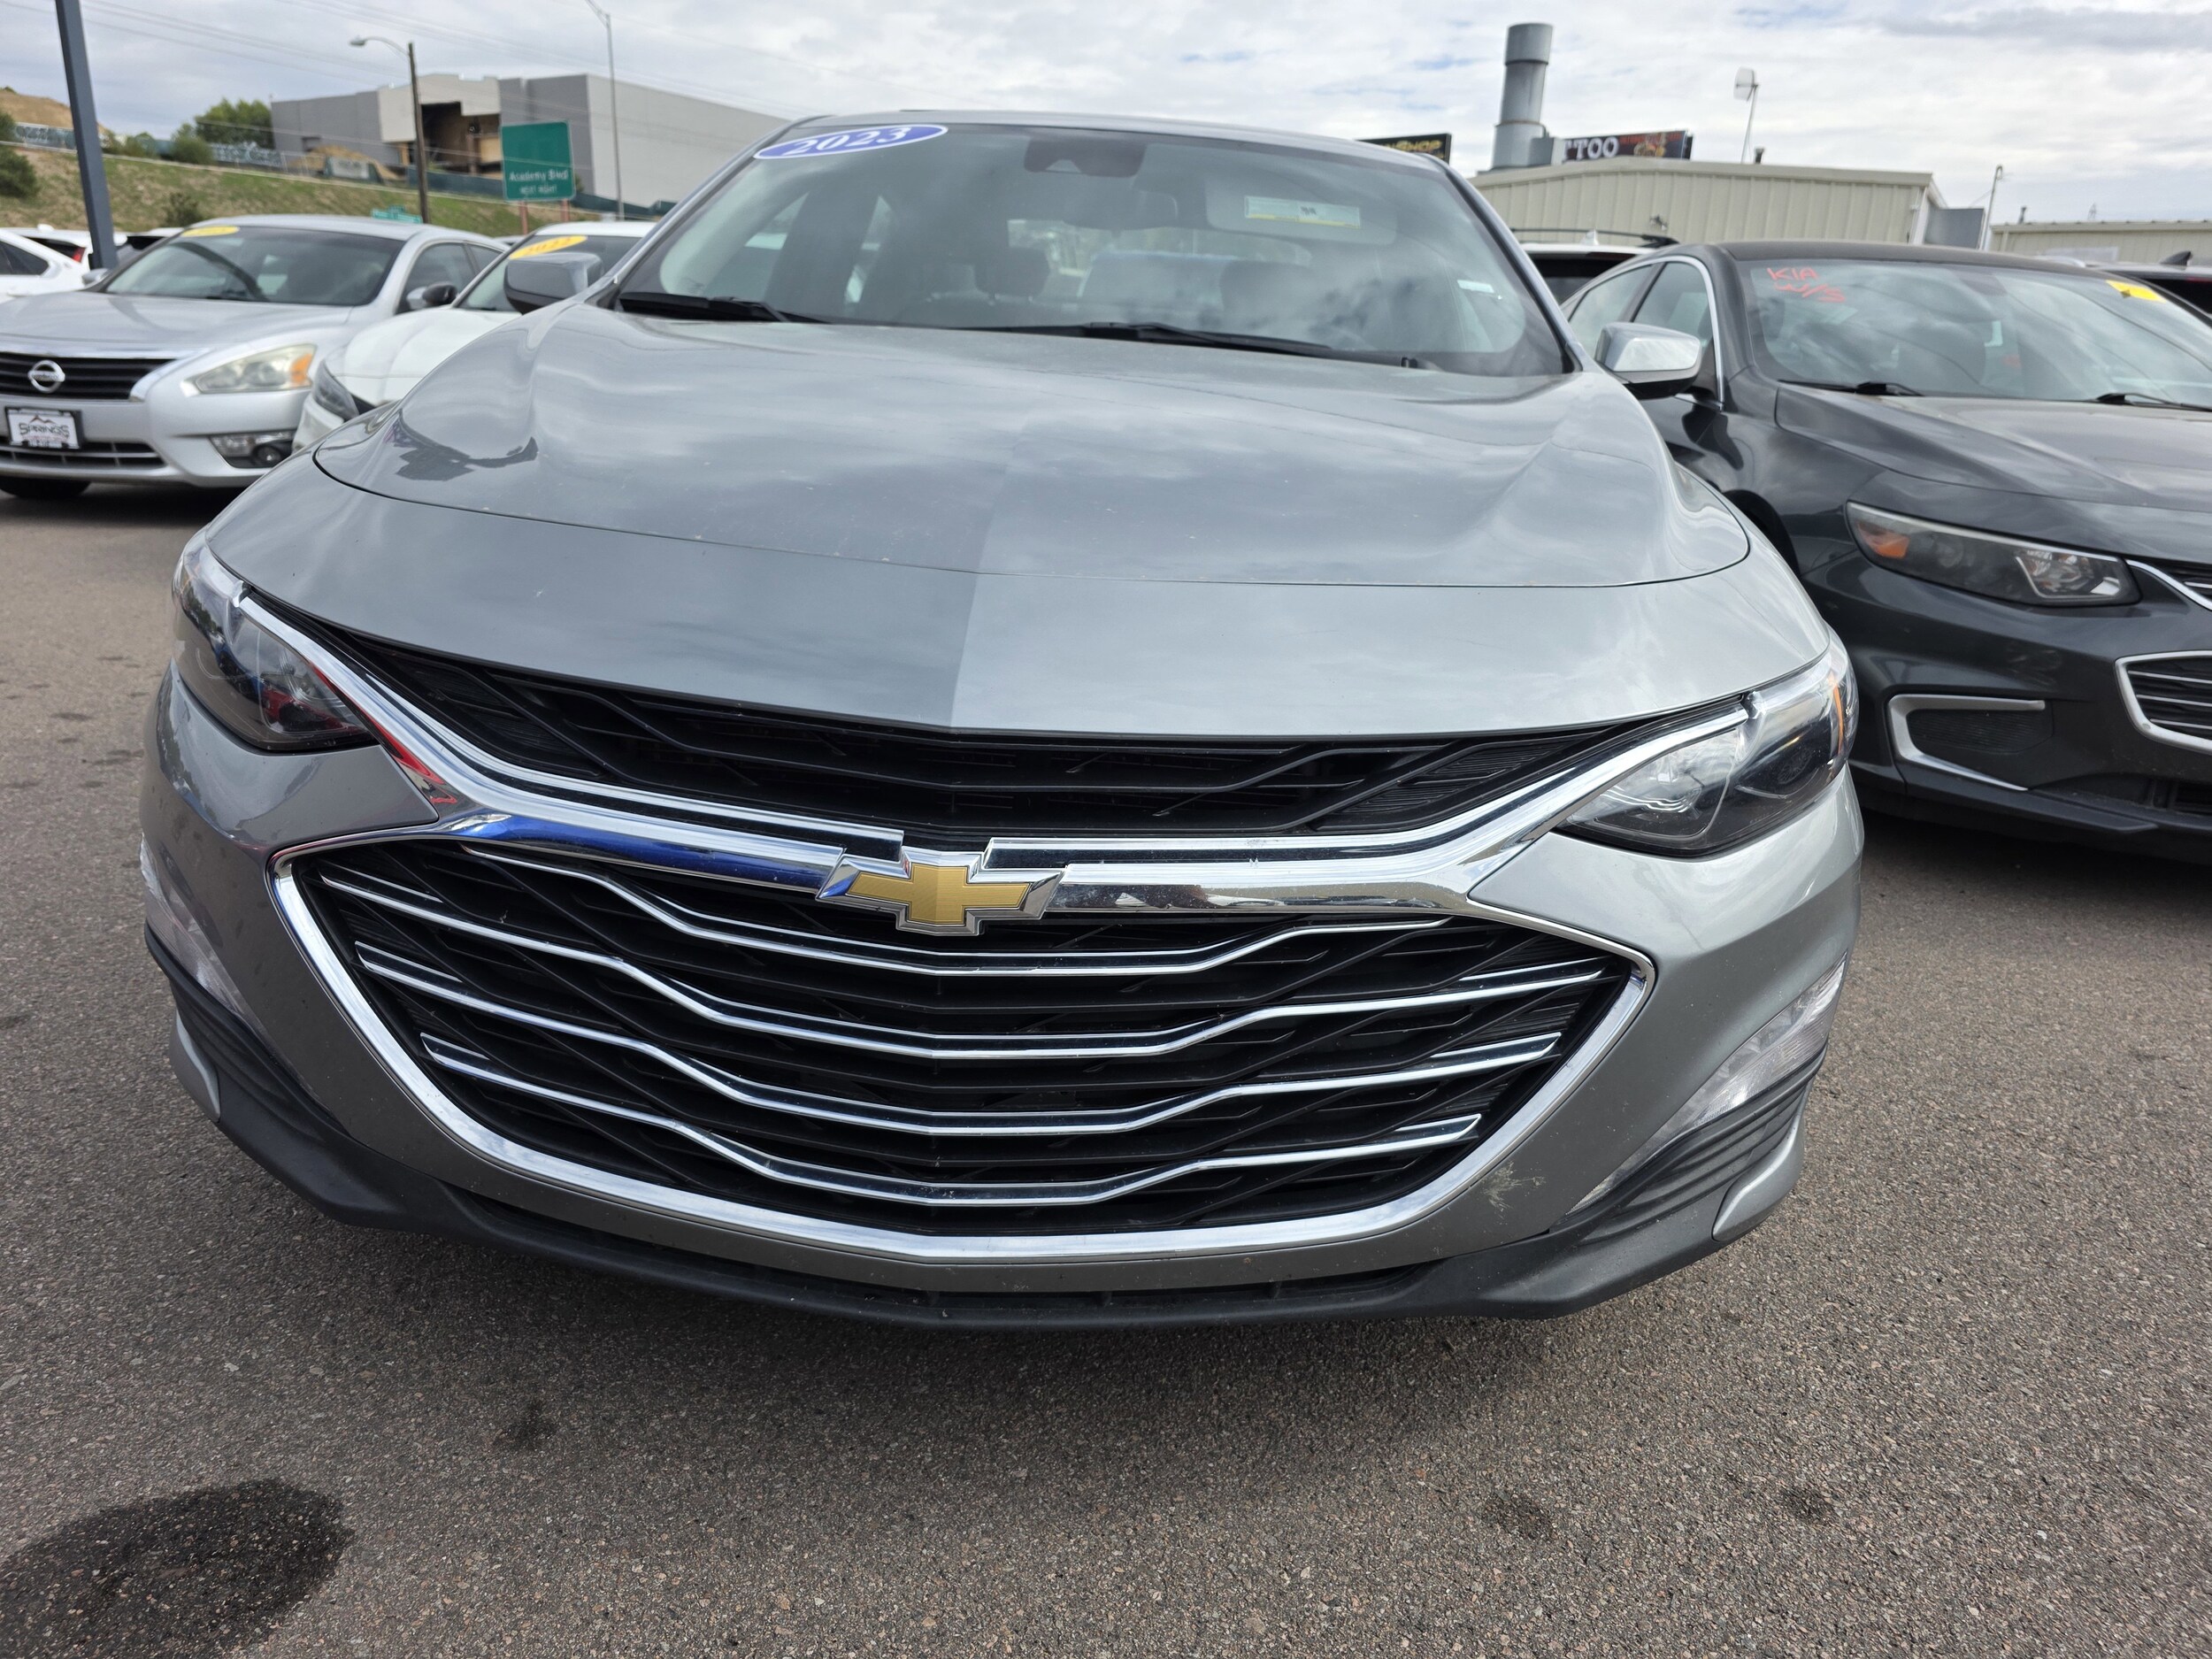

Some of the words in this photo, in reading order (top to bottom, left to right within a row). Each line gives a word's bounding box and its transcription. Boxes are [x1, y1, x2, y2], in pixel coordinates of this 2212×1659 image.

[781, 127, 912, 156] 2023
[510, 171, 546, 181] Academy
[549, 168, 569, 180] Blvd
[1766, 267, 1819, 280] KIA
[19, 422, 70, 439] SPRINGS
